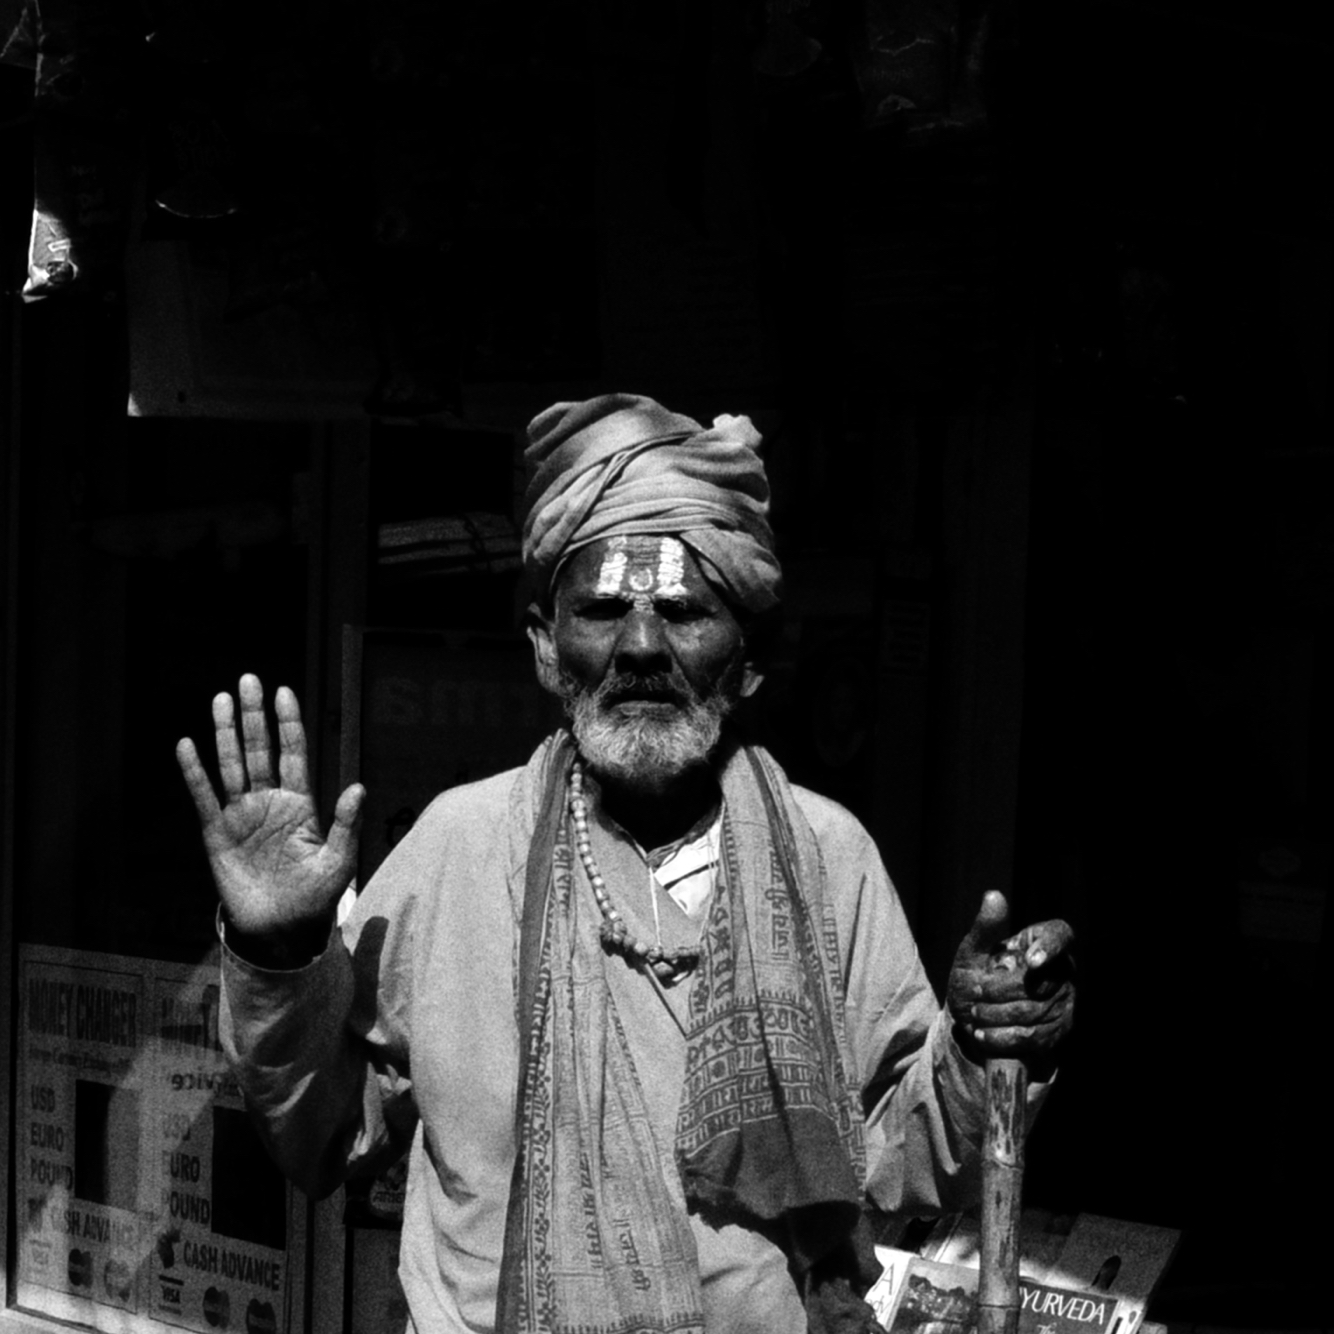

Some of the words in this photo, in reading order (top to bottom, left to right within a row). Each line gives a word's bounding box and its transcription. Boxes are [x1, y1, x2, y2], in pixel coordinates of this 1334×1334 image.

[76, 983, 137, 1049] CHANGER
[30, 1084, 55, 1114] USD
[30, 1122, 65, 1153] EURO
[182, 1239, 219, 1275] CASH
[221, 1248, 281, 1292] ADVANCE
[1018, 1286, 1107, 1326] YURVEDA
